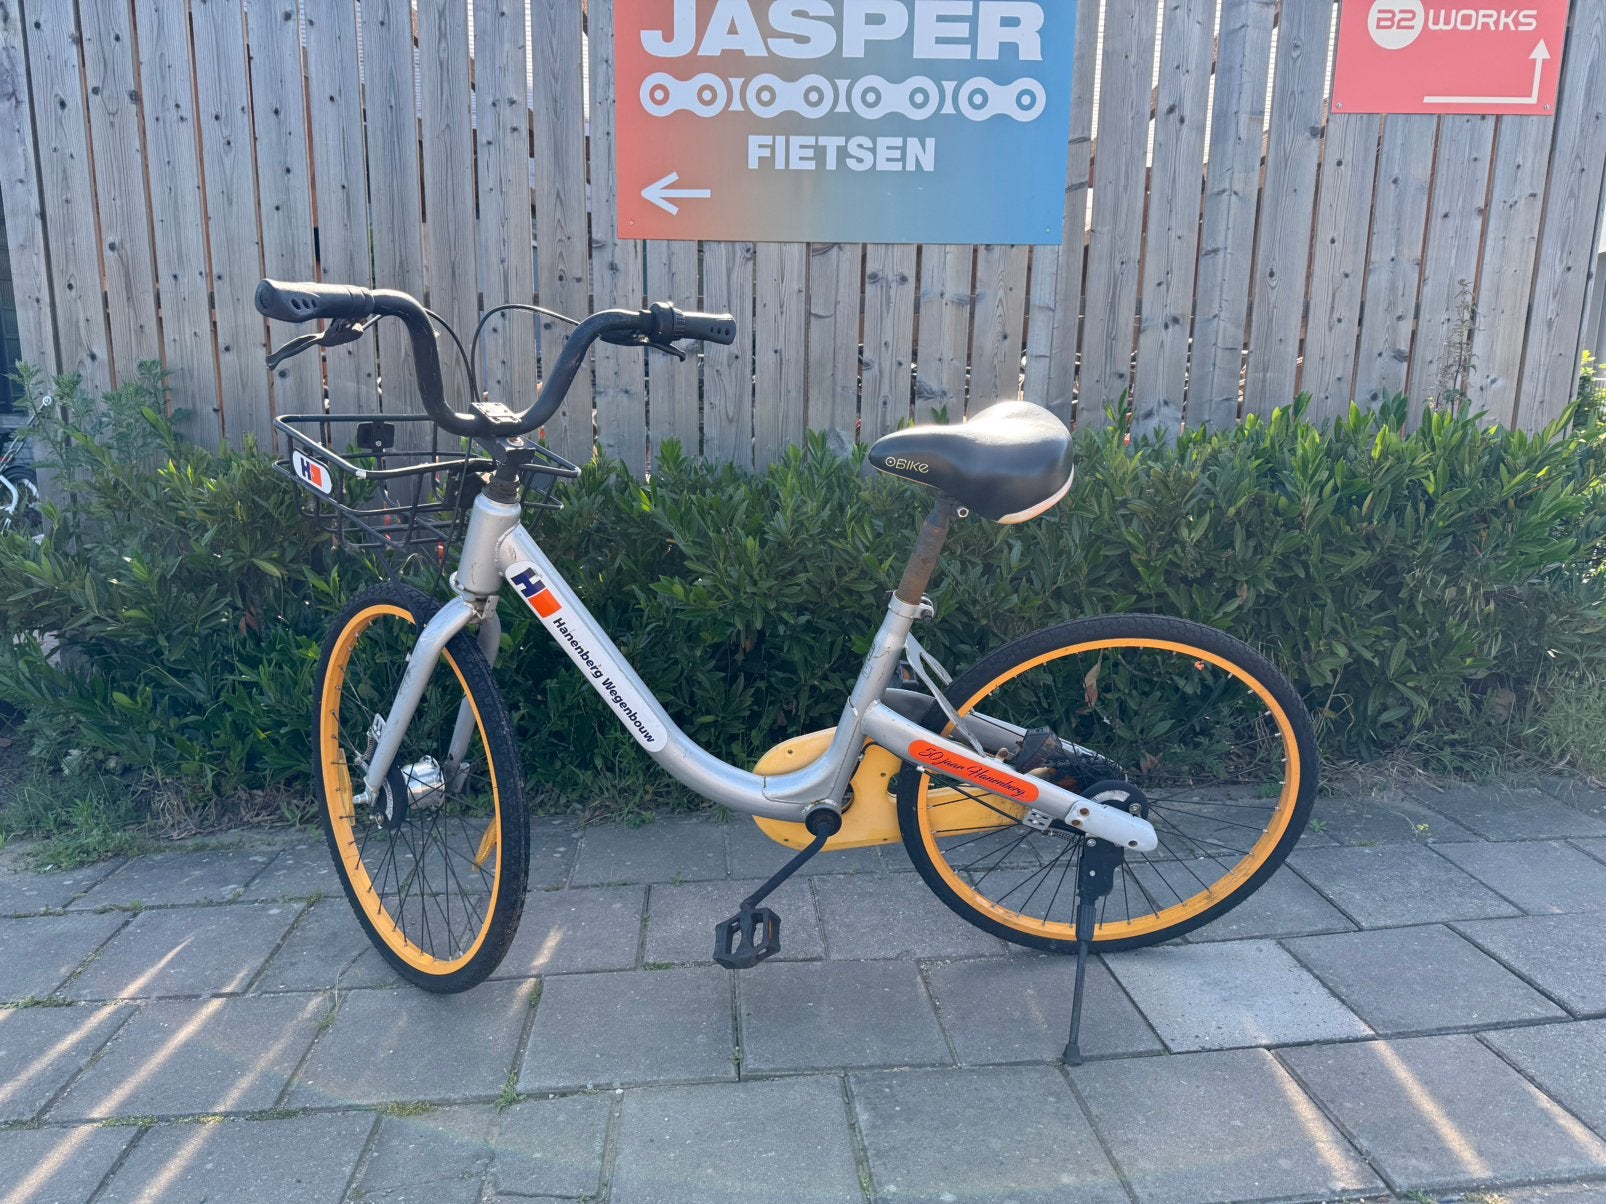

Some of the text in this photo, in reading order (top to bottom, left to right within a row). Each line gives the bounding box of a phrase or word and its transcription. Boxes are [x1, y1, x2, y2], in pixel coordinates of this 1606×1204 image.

[640, 0, 1045, 60] JASPER
[1376, 8, 1537, 31] B2 WORKS
[747, 135, 935, 172] FIETSEN
[553, 617, 655, 743] Hanenberg Wegenbouw
[919, 747, 944, 761] 50
